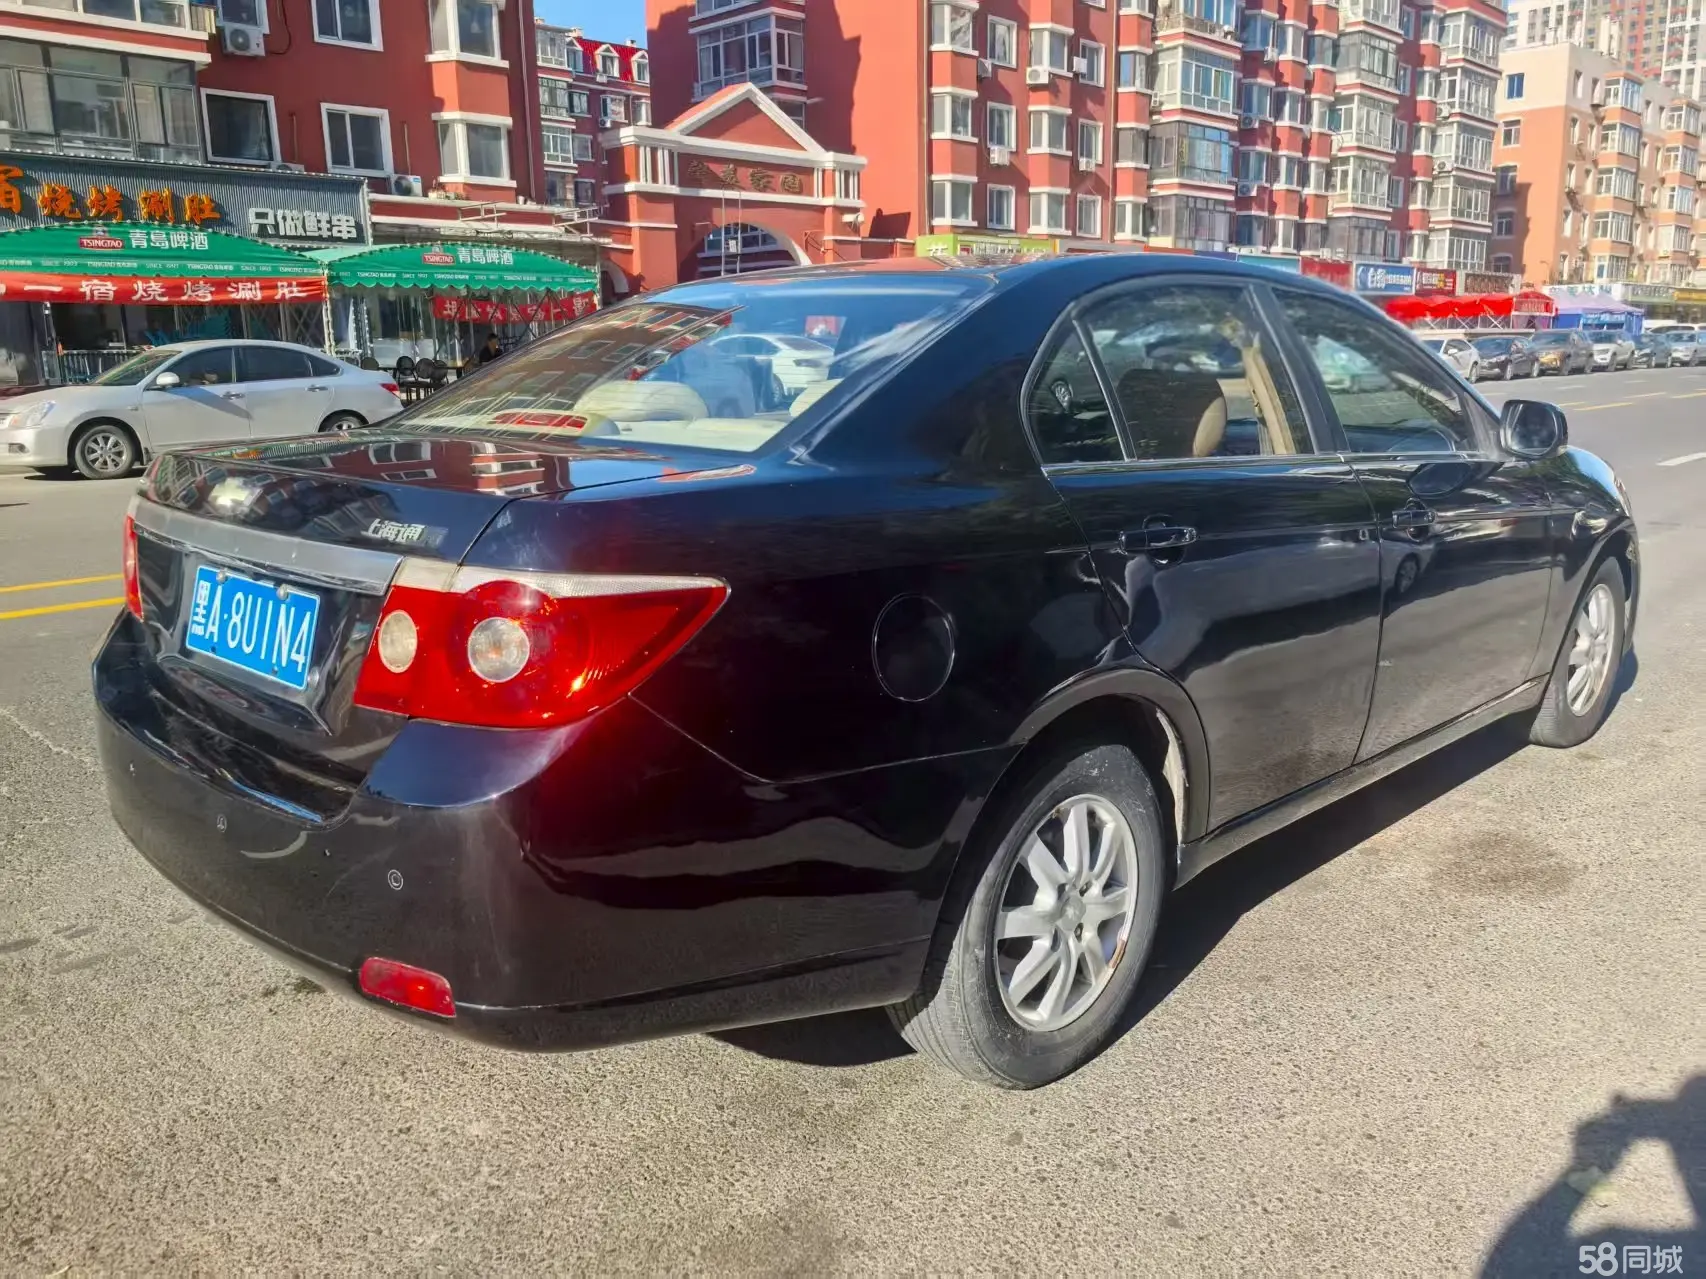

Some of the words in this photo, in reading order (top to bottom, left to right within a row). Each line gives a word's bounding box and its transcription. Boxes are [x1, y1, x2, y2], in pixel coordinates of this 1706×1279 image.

[249, 207, 357, 239] 只做鲜串
[83, 238, 123, 248] TSINGTAO
[129, 229, 209, 250] 青岛啤酒
[424, 255, 453, 264] TSINGTAO
[457, 247, 513, 265] 青岛啤酒
[0, 279, 307, 302] 一宿烧烤涮肚
